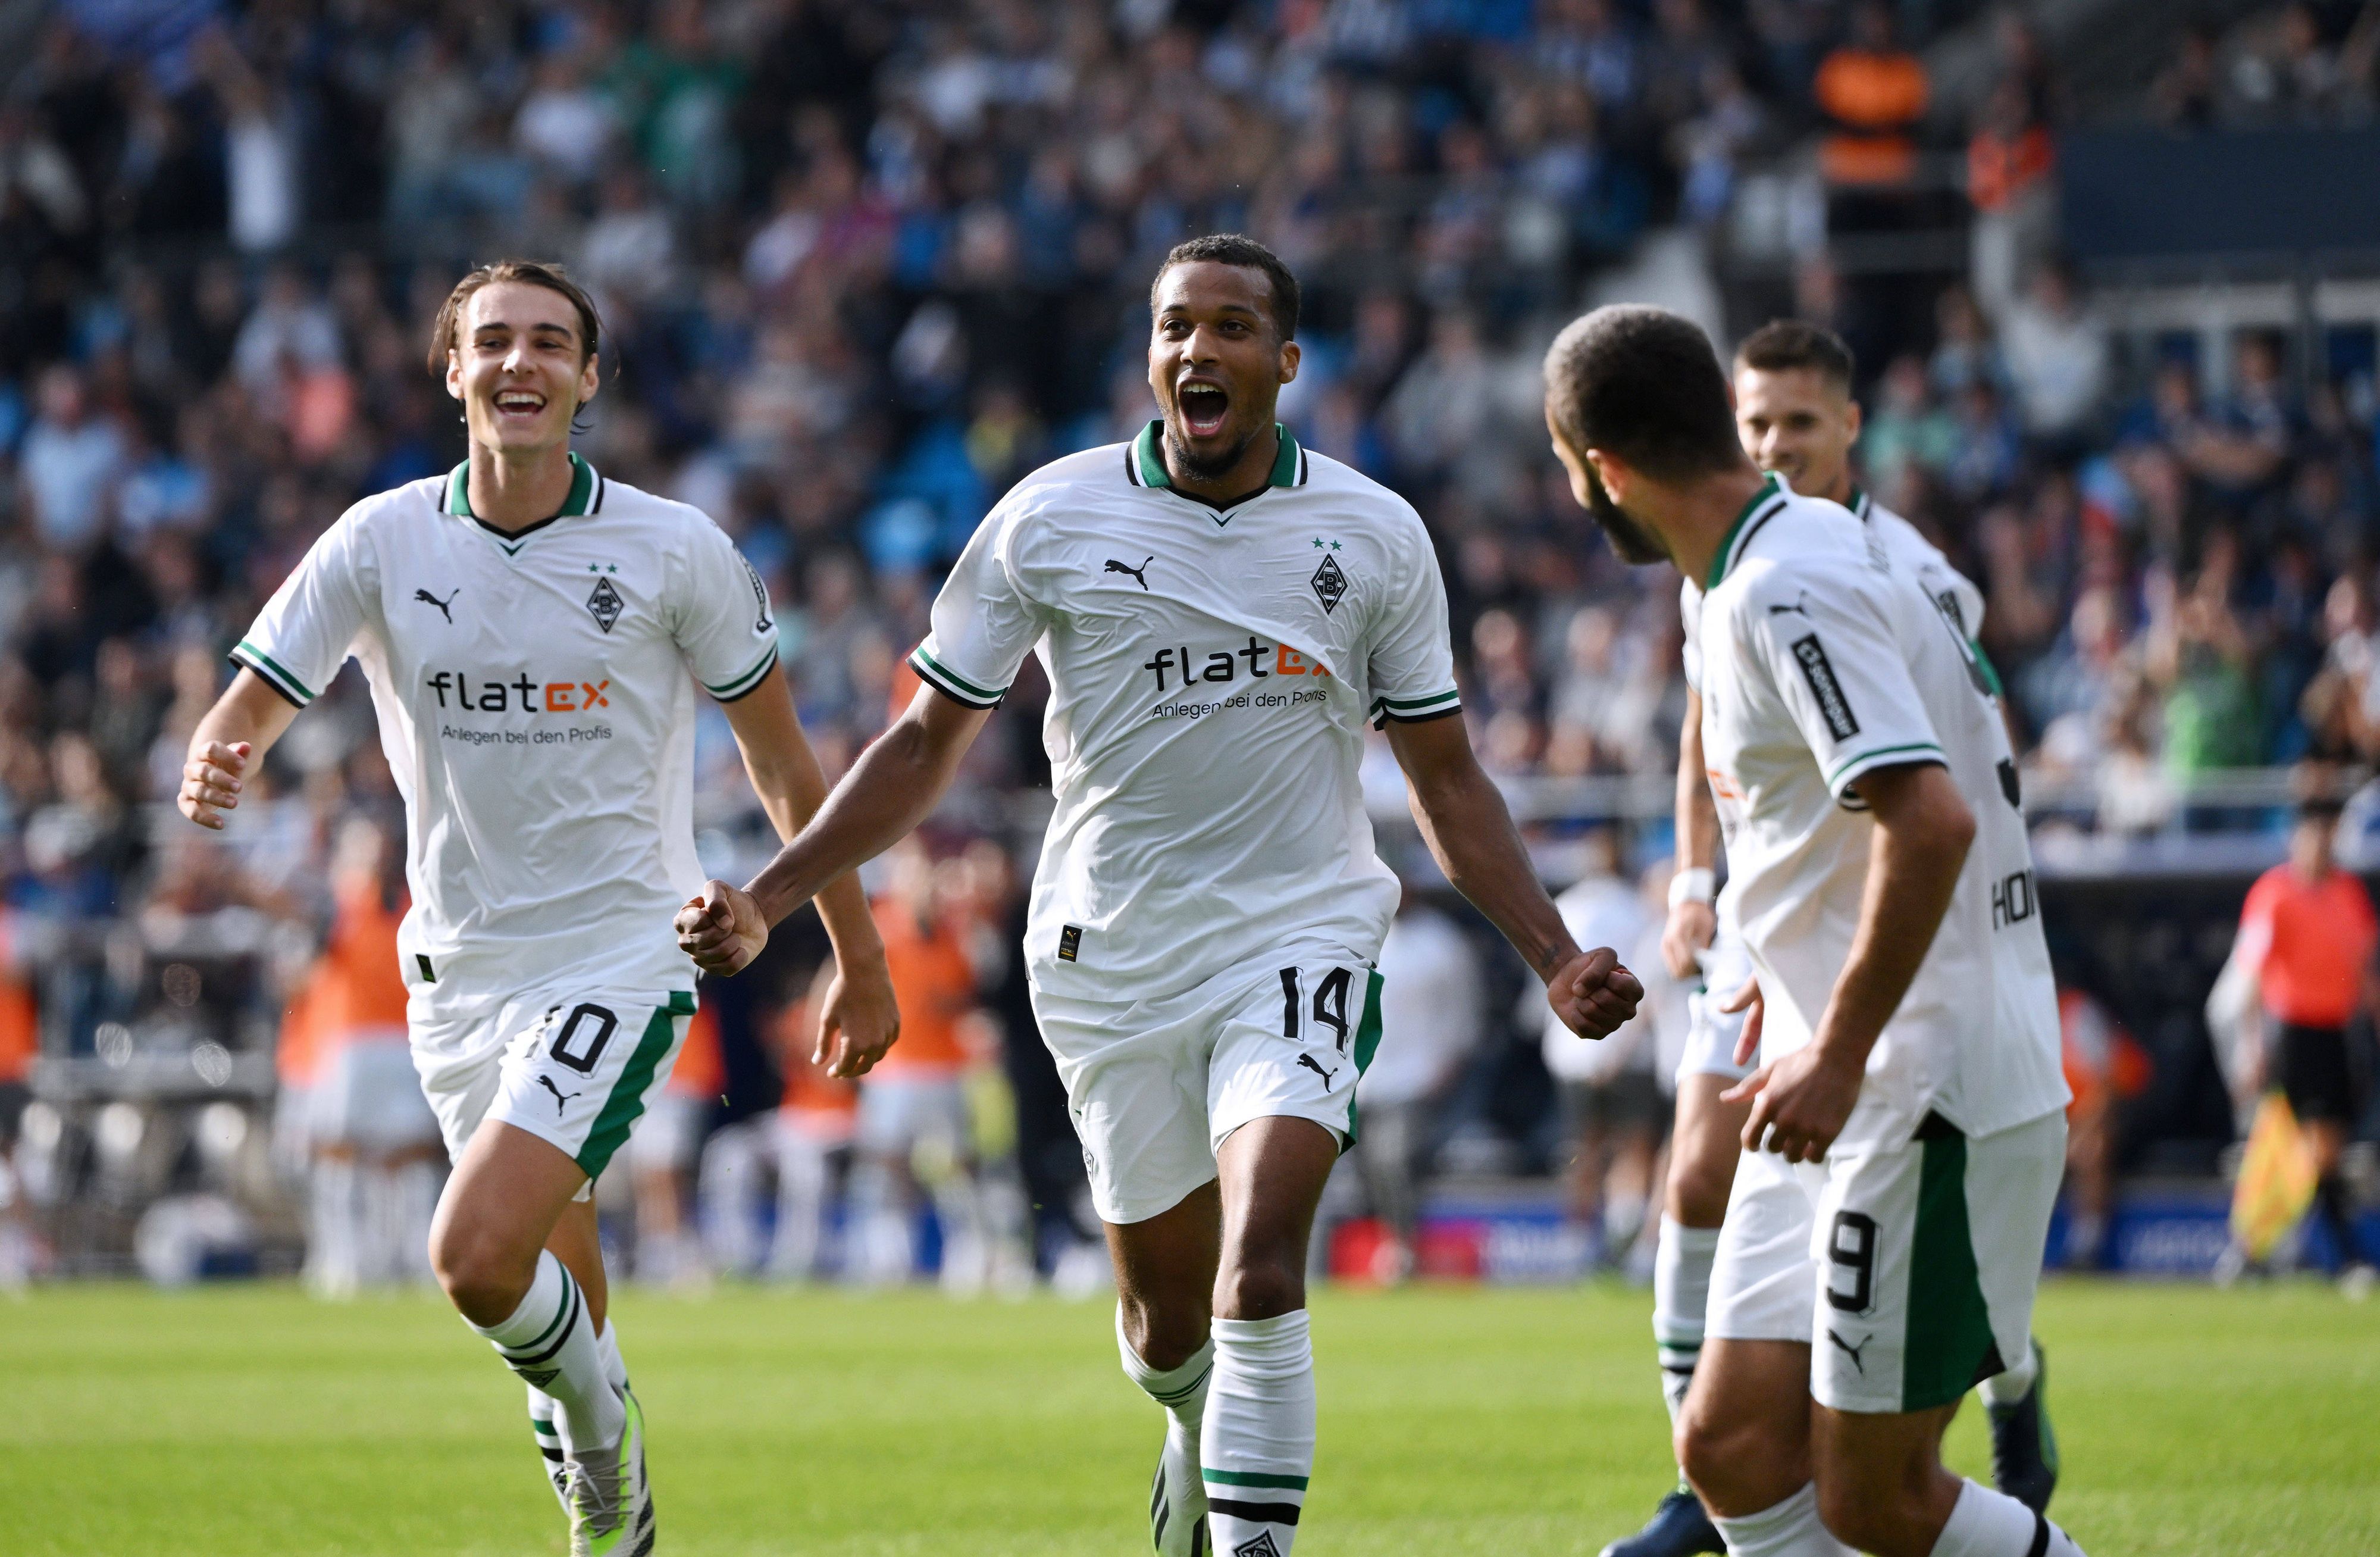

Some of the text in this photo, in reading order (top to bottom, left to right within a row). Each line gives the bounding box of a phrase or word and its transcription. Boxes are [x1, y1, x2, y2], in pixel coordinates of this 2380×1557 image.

[1323, 572, 1338, 595] B
[597, 595, 612, 614] B
[1152, 702, 1221, 719] Anlegen
[1225, 693, 1250, 708] bei
[1255, 692, 1287, 708] den
[441, 725, 612, 745] Anlegen bei den Profis
[1279, 966, 1355, 1060] 14
[1827, 1210, 1883, 1318] 9
